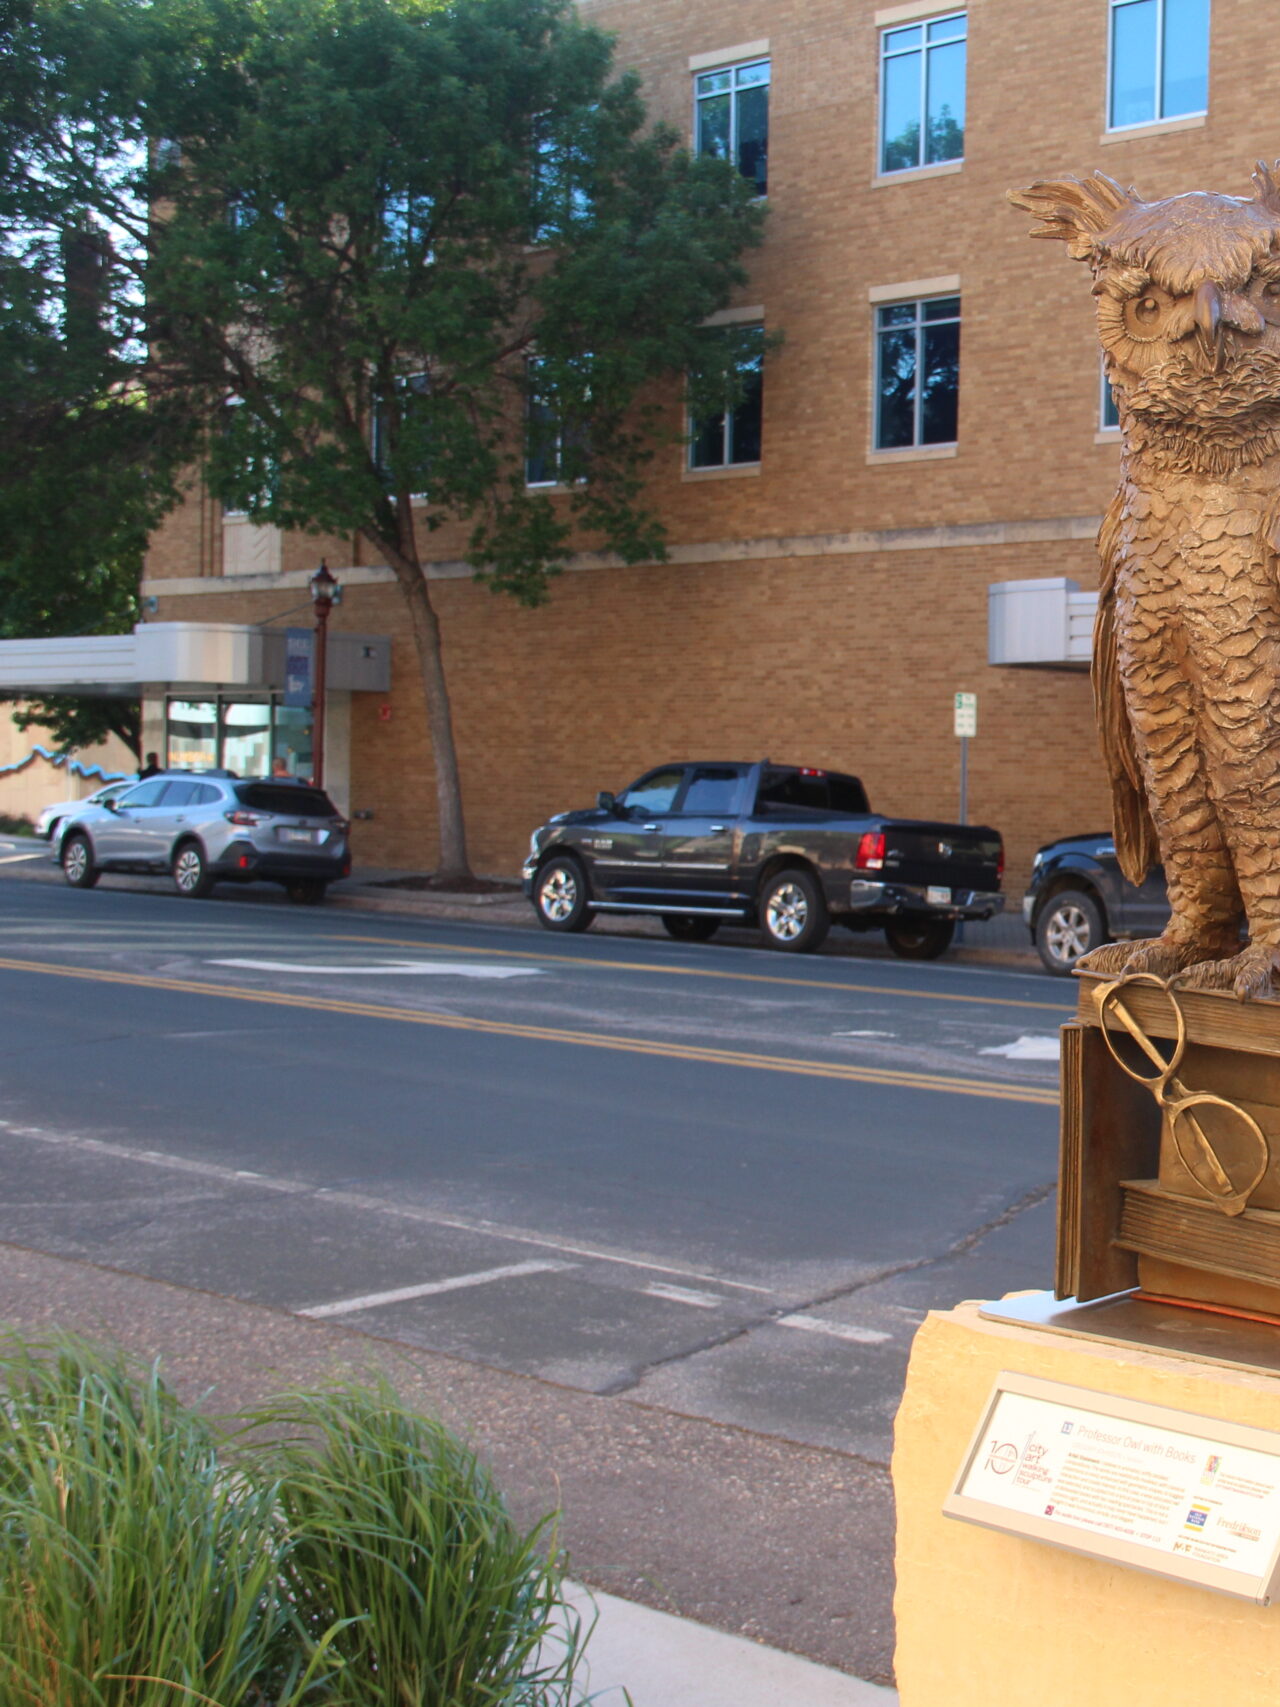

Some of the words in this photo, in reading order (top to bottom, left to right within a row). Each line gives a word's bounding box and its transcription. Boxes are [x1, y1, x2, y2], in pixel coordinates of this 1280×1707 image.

[1029, 1443, 1049, 1457] city
[1076, 1424, 1122, 1445] Professor
[1123, 1436, 1142, 1451] Owl
[1142, 1441, 1165, 1457] with
[1165, 1446, 1197, 1464] Books
[1024, 1453, 1041, 1464] art
[1019, 1469, 1053, 1484] sculpture
